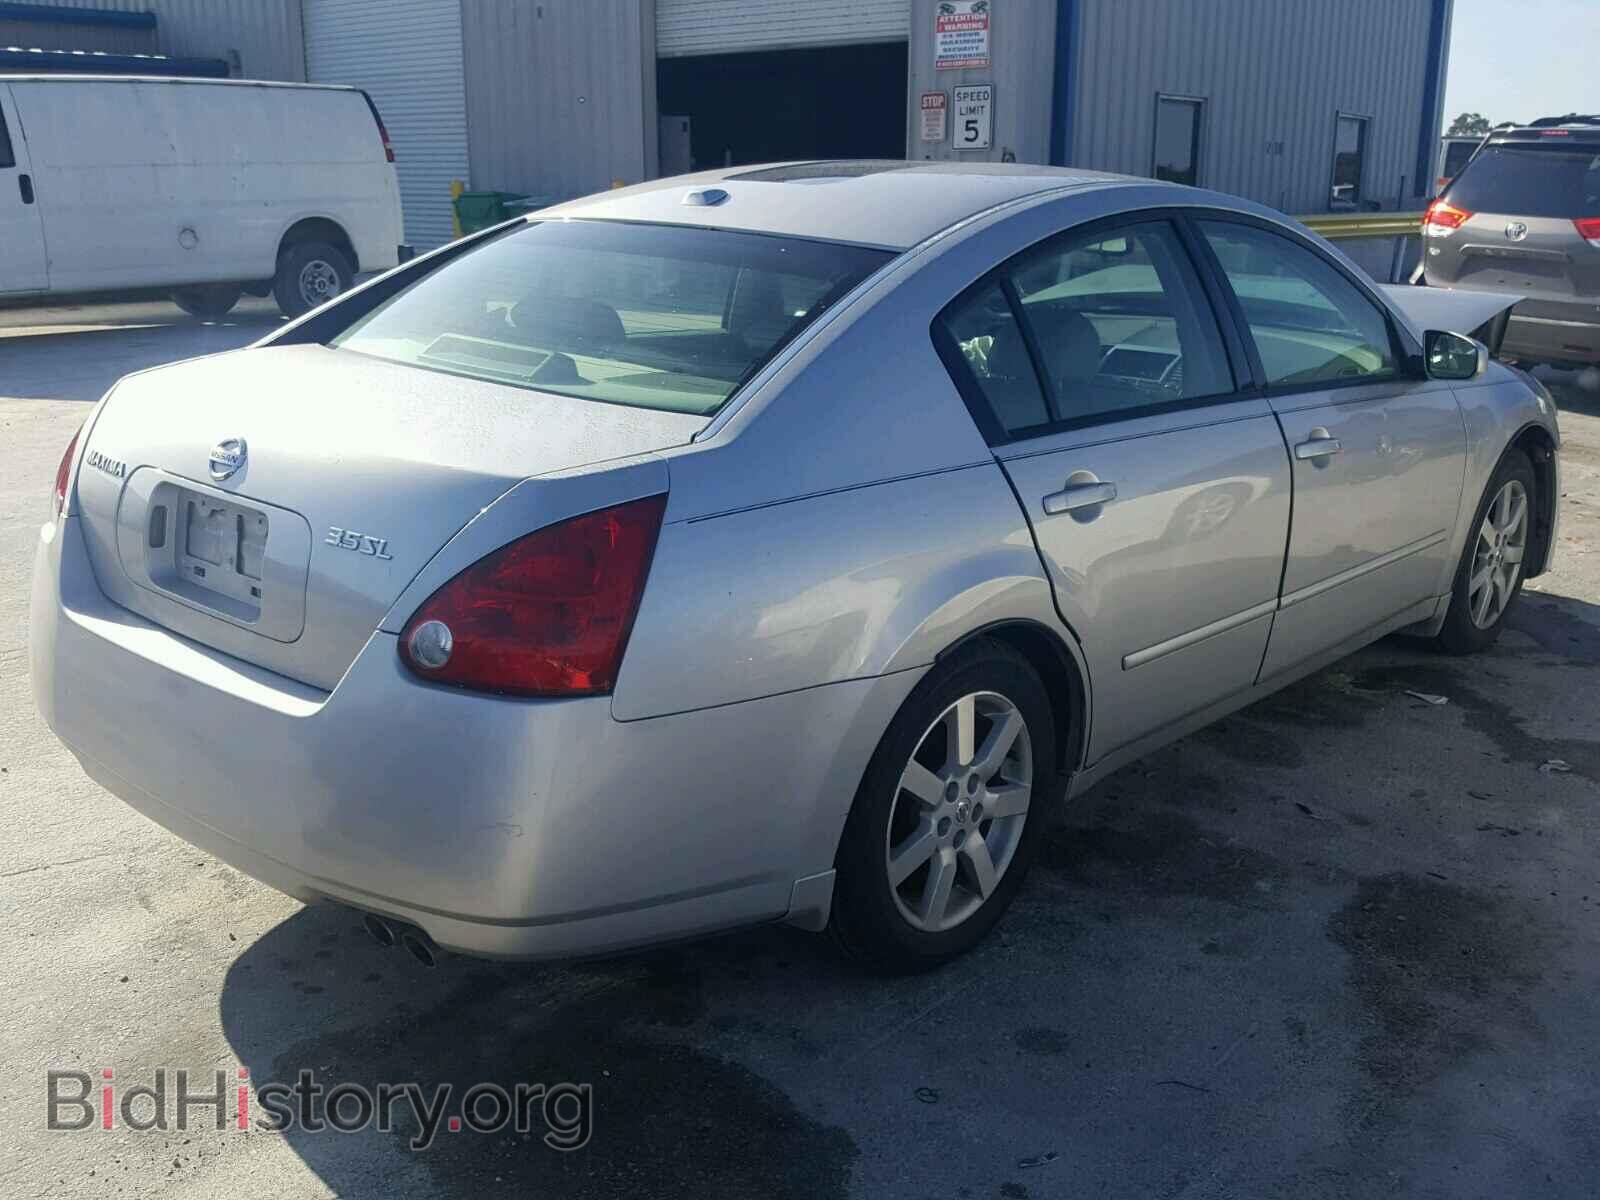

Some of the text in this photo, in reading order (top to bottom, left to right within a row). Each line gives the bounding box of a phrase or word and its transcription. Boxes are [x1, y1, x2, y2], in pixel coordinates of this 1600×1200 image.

[939, 14, 987, 23] ATTENTION
[944, 22, 984, 31] WARNING
[922, 95, 944, 107] STOP
[956, 90, 990, 102] SPEED
[959, 105, 985, 116] LIMIT
[964, 119, 979, 143] 5
